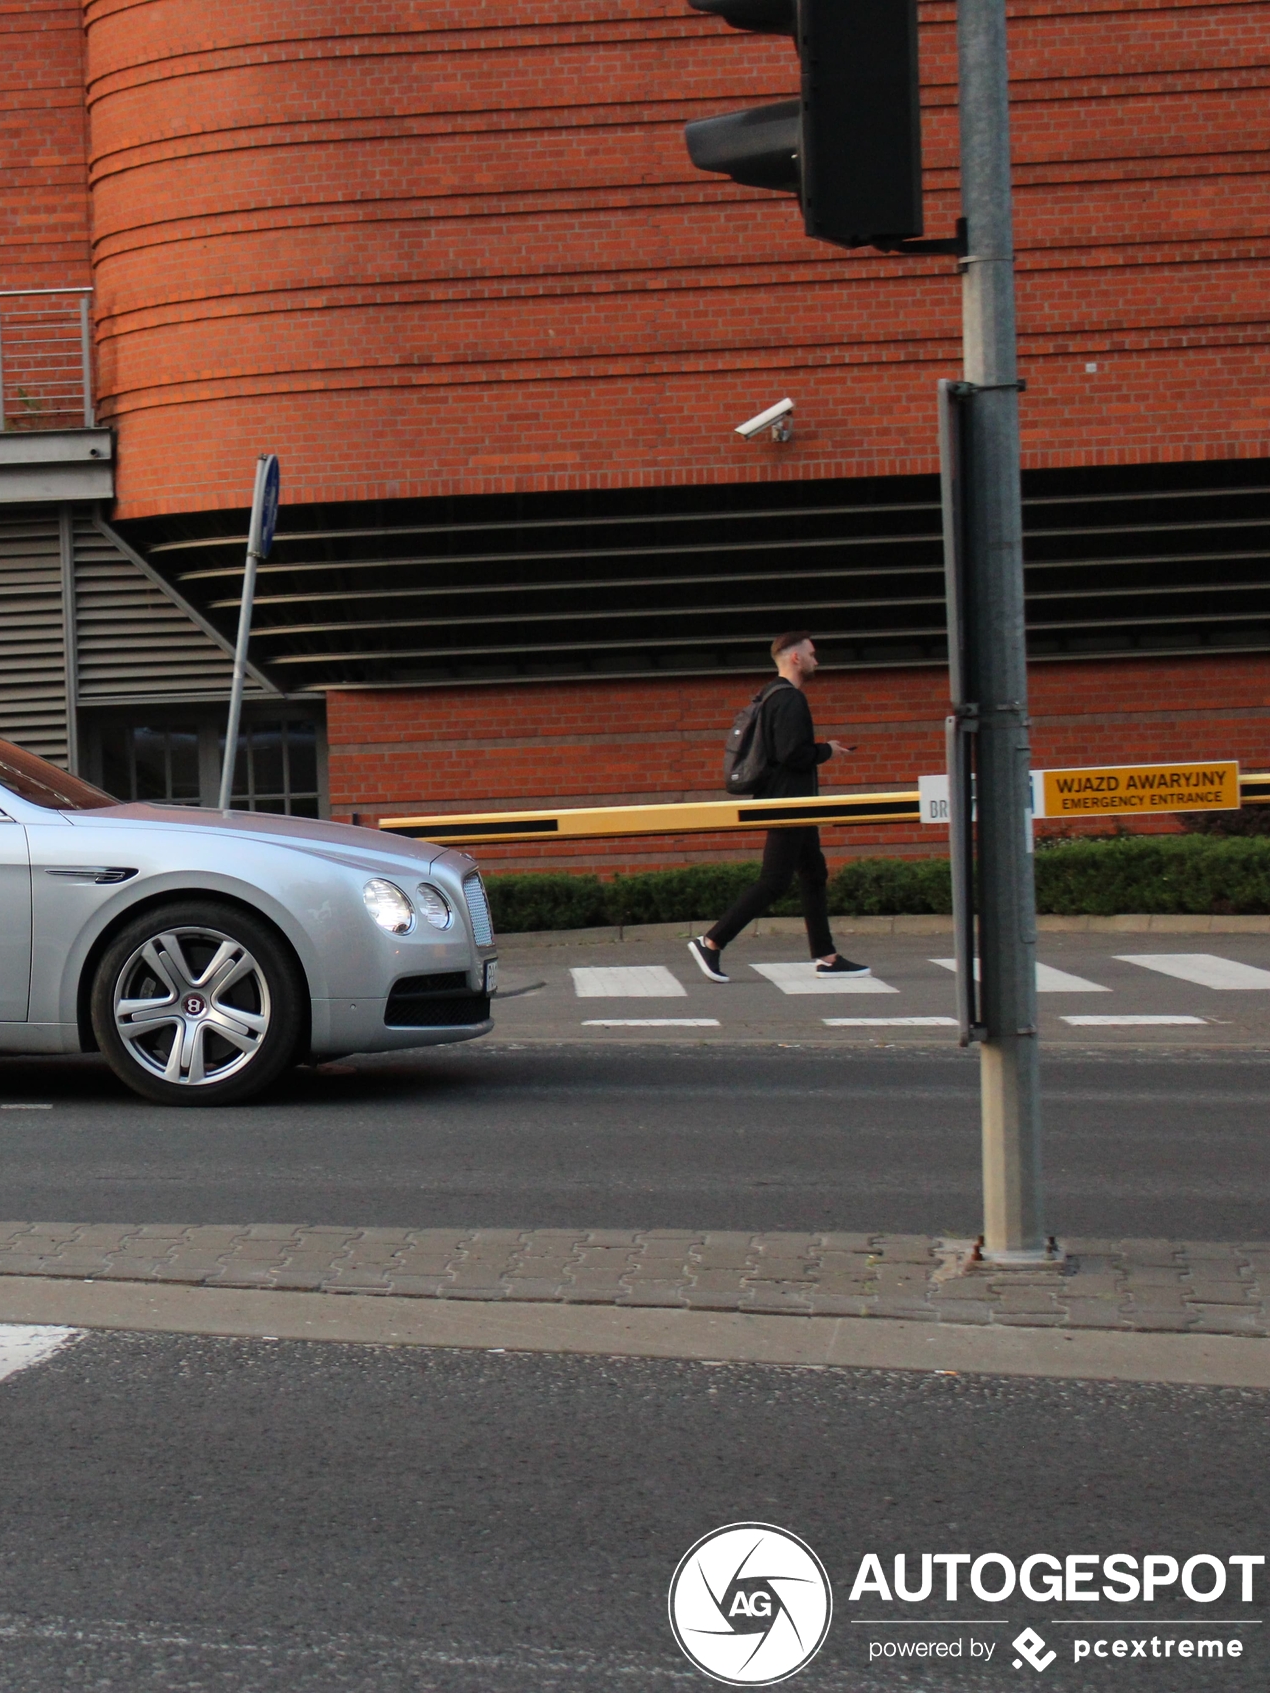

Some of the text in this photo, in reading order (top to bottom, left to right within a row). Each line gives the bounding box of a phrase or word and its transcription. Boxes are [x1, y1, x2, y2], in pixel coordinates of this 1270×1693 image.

[1056, 771, 1226, 794] WJAZD AWARYJNY
[1062, 791, 1223, 810] EMERGENCY ENTRANCE
